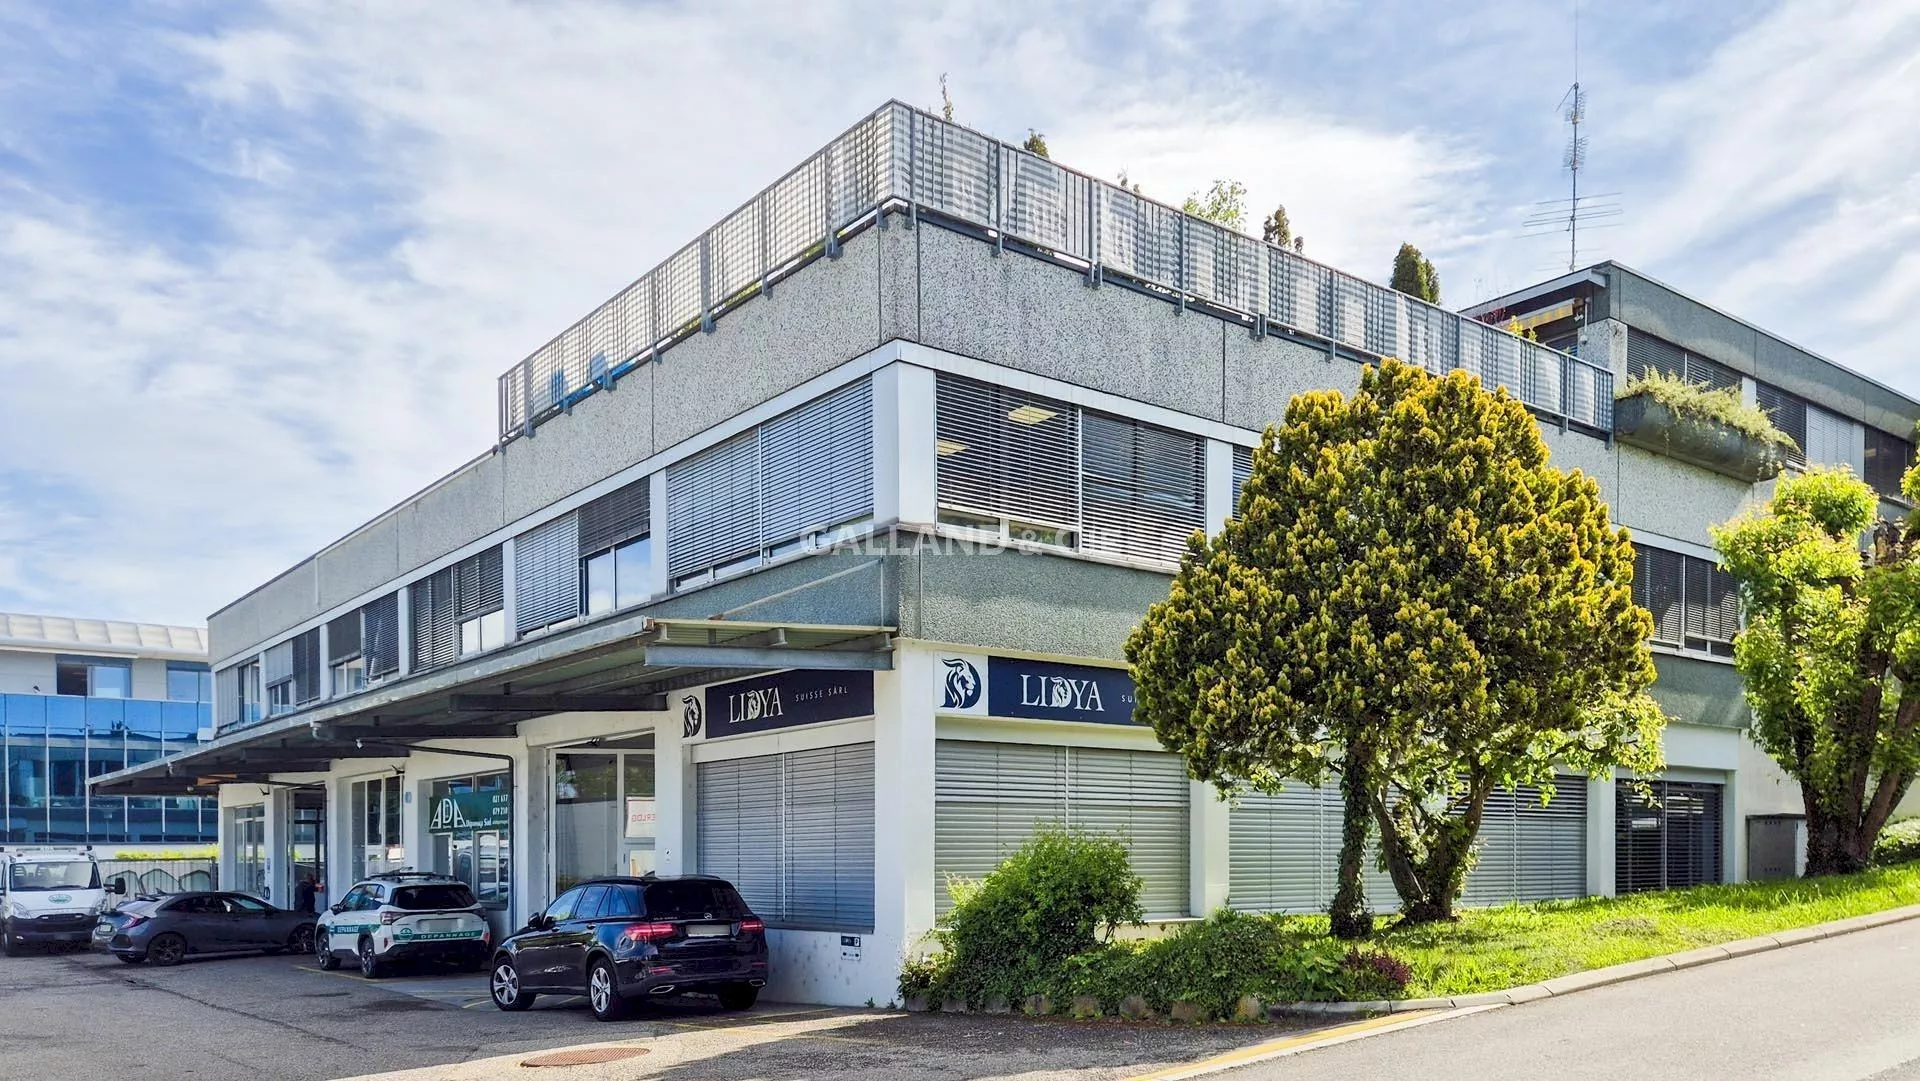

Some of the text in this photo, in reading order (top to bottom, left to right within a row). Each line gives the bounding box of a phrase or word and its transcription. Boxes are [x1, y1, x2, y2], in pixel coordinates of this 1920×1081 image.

[728, 687, 784, 724] LIDYA
[795, 689, 823, 702] SUISSE
[1020, 674, 1105, 712] LIDYA
